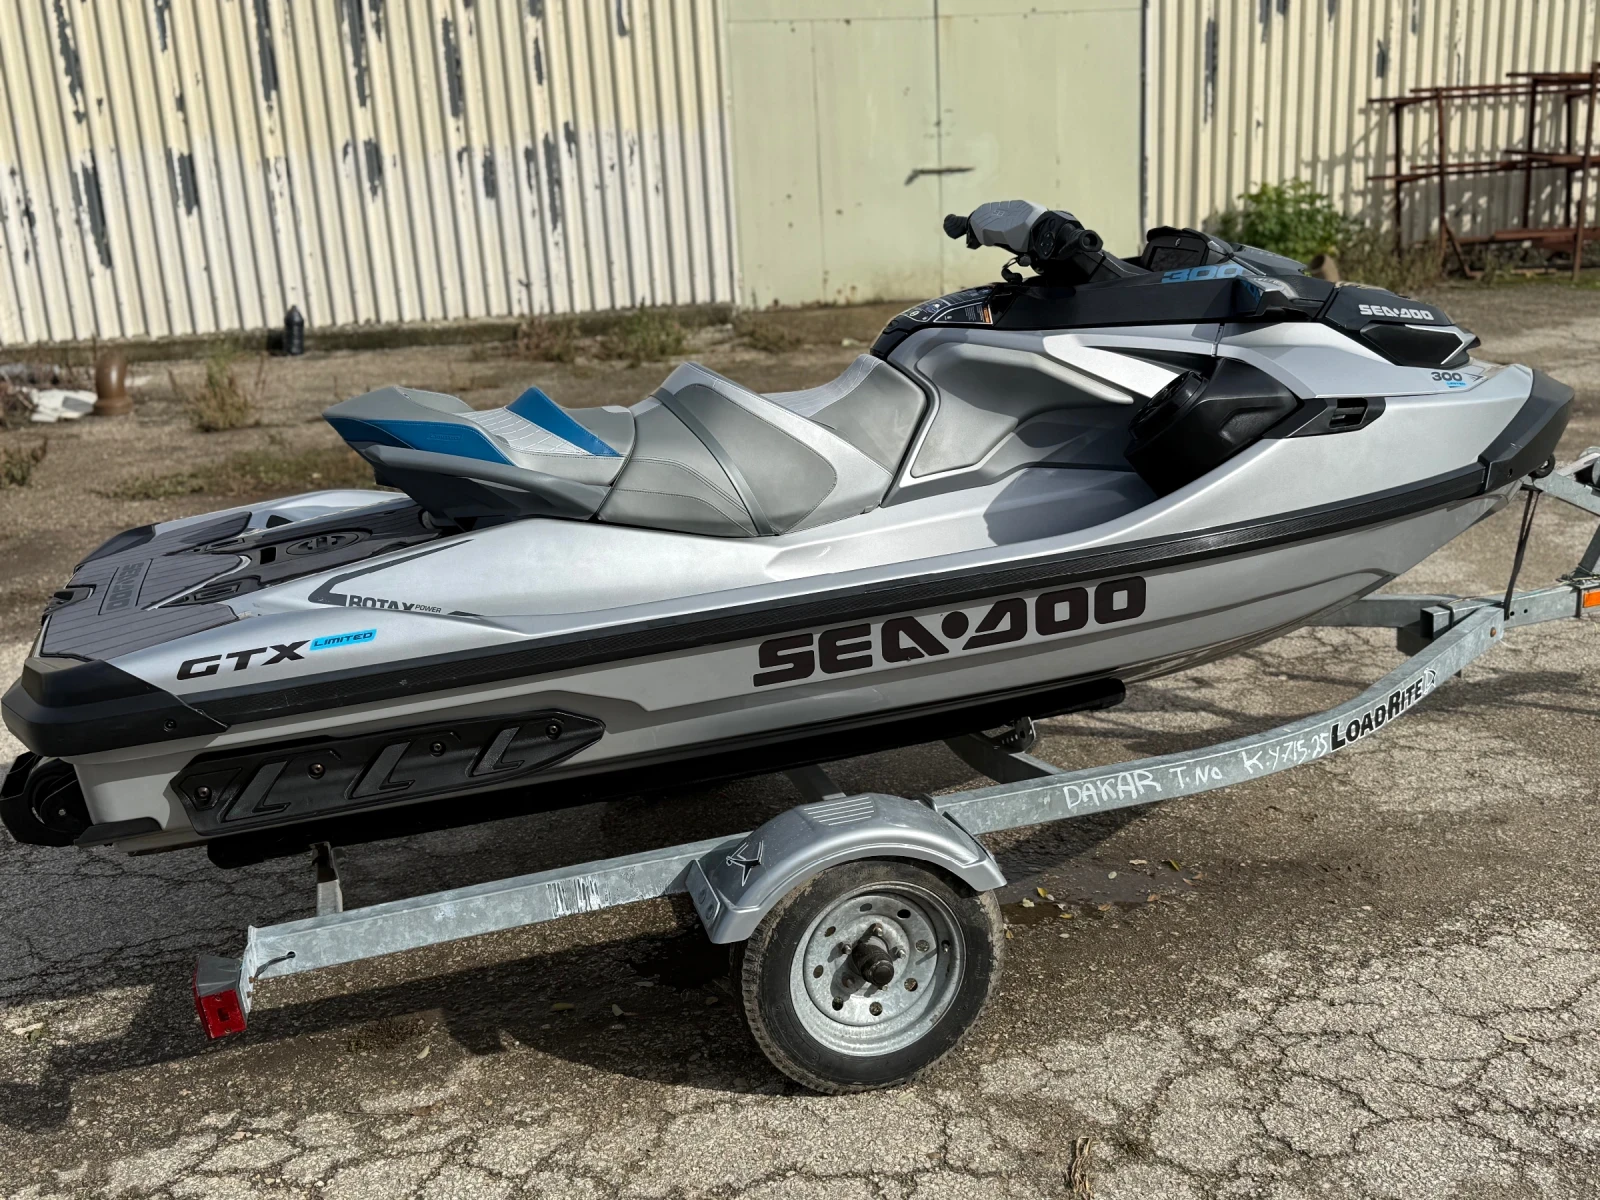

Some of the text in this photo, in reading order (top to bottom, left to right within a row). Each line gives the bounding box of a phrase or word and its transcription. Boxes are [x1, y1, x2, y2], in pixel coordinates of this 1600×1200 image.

[1161, 263, 1244, 284] 300
[1431, 371, 1463, 382] 300
[415, 603, 442, 613] POWER
[177, 629, 374, 681] GTX LIMITED
[1063, 769, 1162, 810] DAKAR
